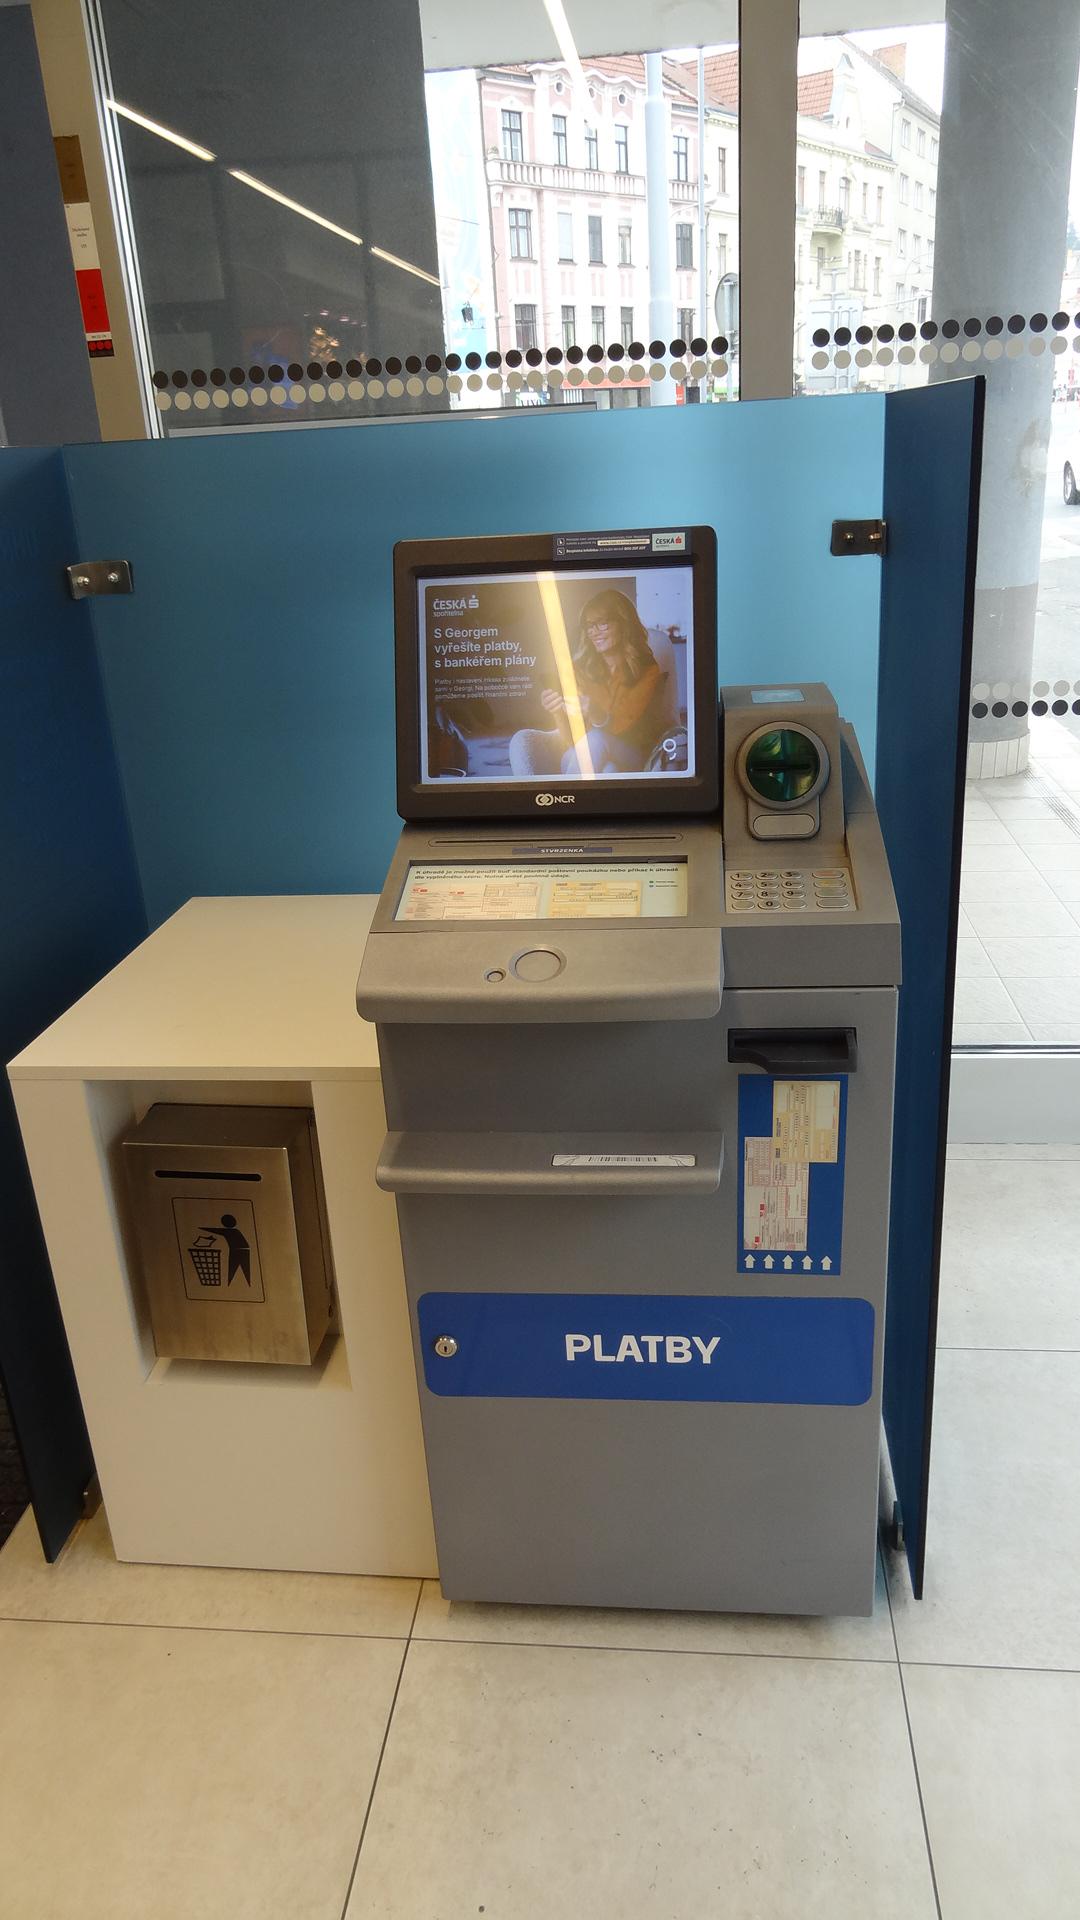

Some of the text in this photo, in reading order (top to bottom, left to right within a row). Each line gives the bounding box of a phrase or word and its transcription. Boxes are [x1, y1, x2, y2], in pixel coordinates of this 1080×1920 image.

[433, 598, 466, 610] ČESKÁ
[434, 628, 498, 640] S Georgem
[434, 640, 522, 656] vyřešíte platby,
[434, 654, 536, 668] s bankéřem plány
[554, 795, 575, 803] NCR
[565, 1334, 721, 1364] PLATBY
